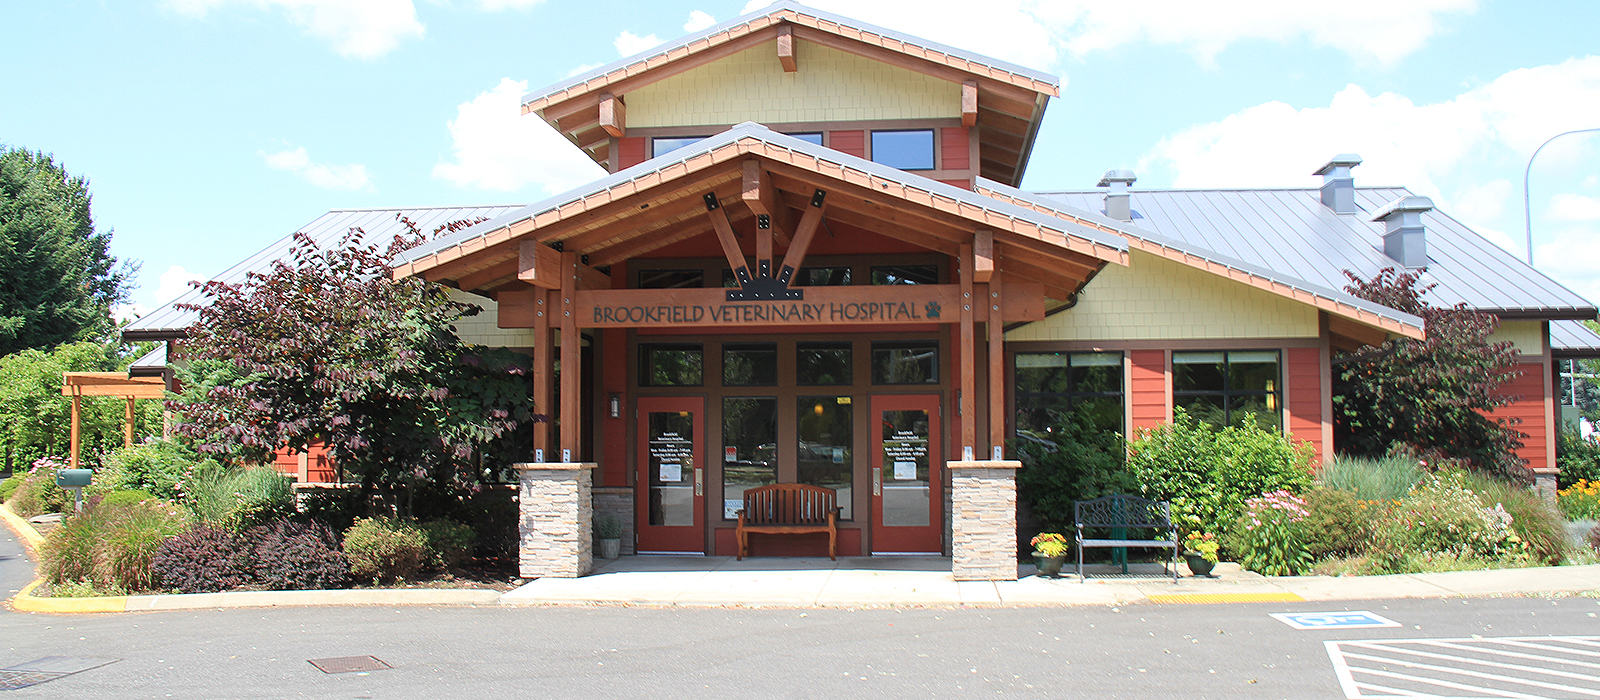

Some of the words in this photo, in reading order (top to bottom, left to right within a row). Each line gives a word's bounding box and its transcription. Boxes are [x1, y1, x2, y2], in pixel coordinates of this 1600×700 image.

[593, 305, 705, 323] BROOKFIELD
[709, 303, 826, 322] VETERINARY
[830, 301, 921, 320] HOSPITAL
